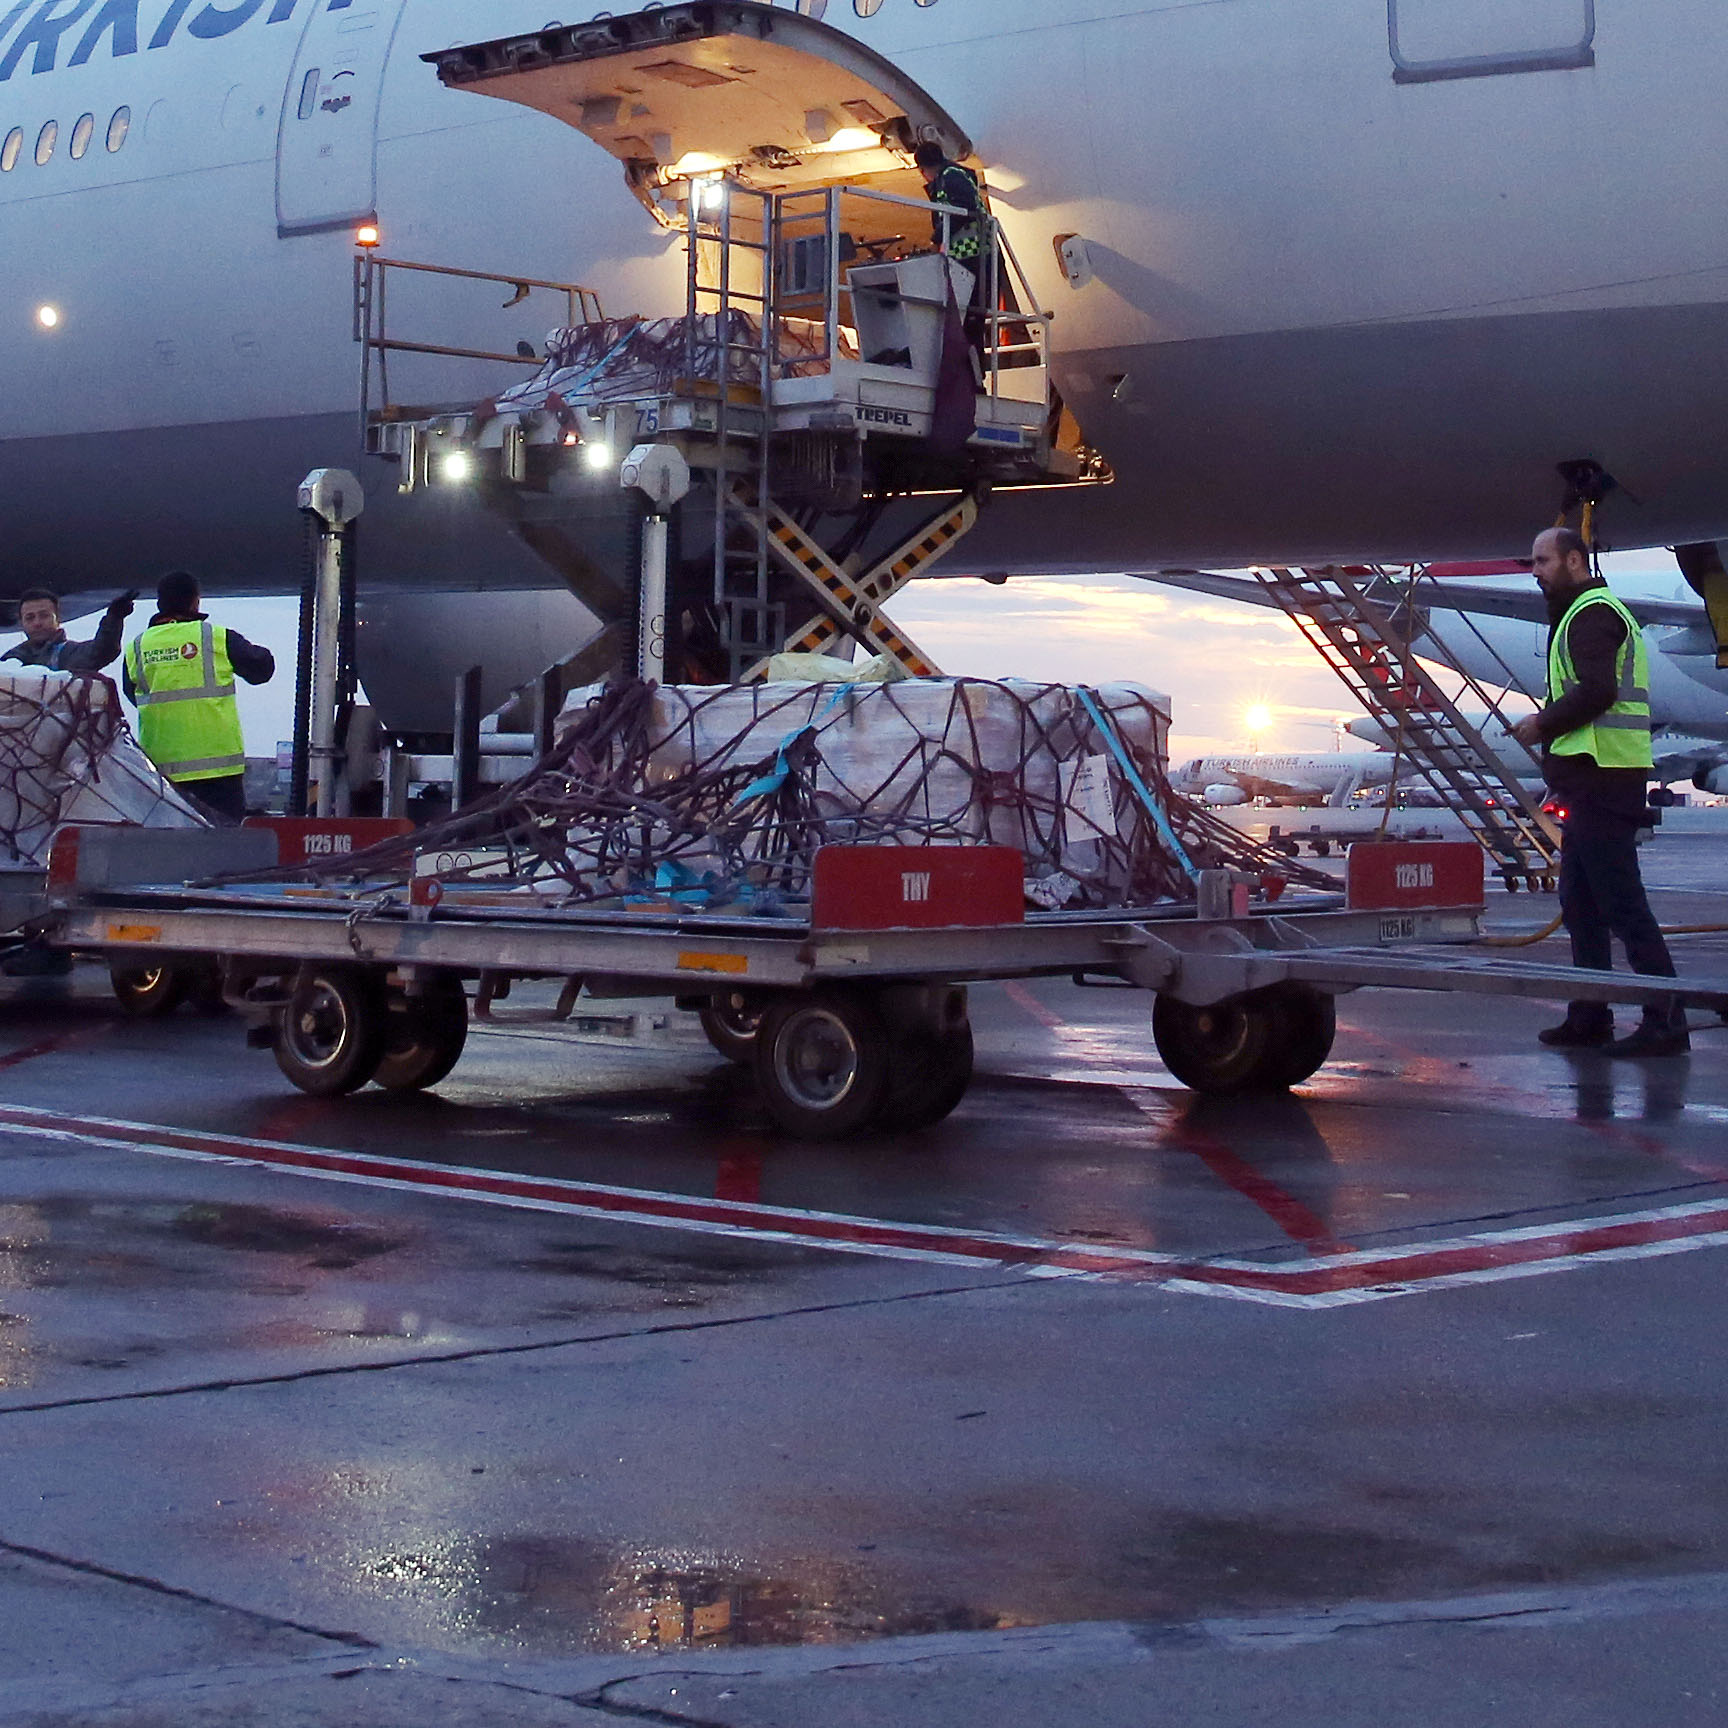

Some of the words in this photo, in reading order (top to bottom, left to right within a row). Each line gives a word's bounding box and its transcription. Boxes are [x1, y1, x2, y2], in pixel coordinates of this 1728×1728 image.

[635, 408, 659, 434] 75
[144, 648, 179, 658] TURKISH
[144, 654, 179, 663] AIRLINES
[303, 835, 332, 853] 1125
[334, 835, 352, 853] KG
[1396, 864, 1419, 888] 1125
[1419, 863, 1434, 887] KG
[901, 872, 931, 901] THY
[1380, 919, 1400, 939] 1125
